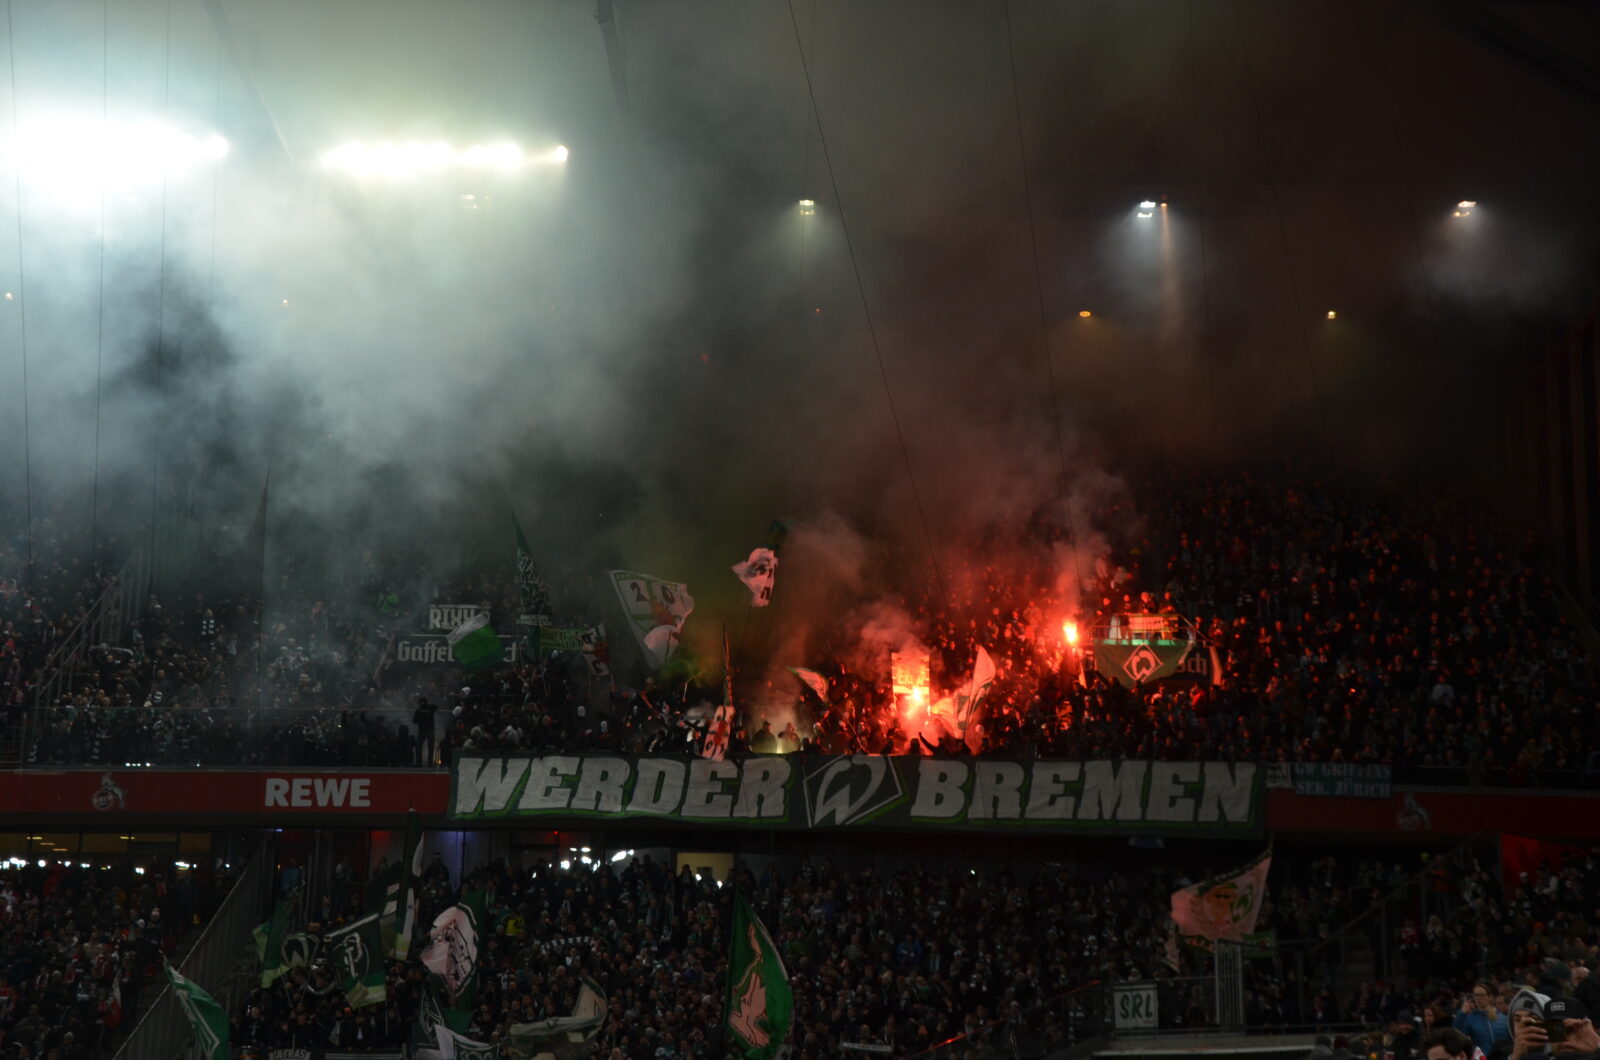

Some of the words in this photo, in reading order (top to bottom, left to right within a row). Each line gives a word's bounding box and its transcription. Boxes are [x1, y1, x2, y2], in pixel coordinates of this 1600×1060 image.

[264, 777, 372, 808] REWE
[454, 754, 792, 819] WERDER
[909, 758, 1256, 824] BREMEN
[1120, 993, 1153, 1020] SRL
[272, 1048, 307, 1059] ULTRAS
